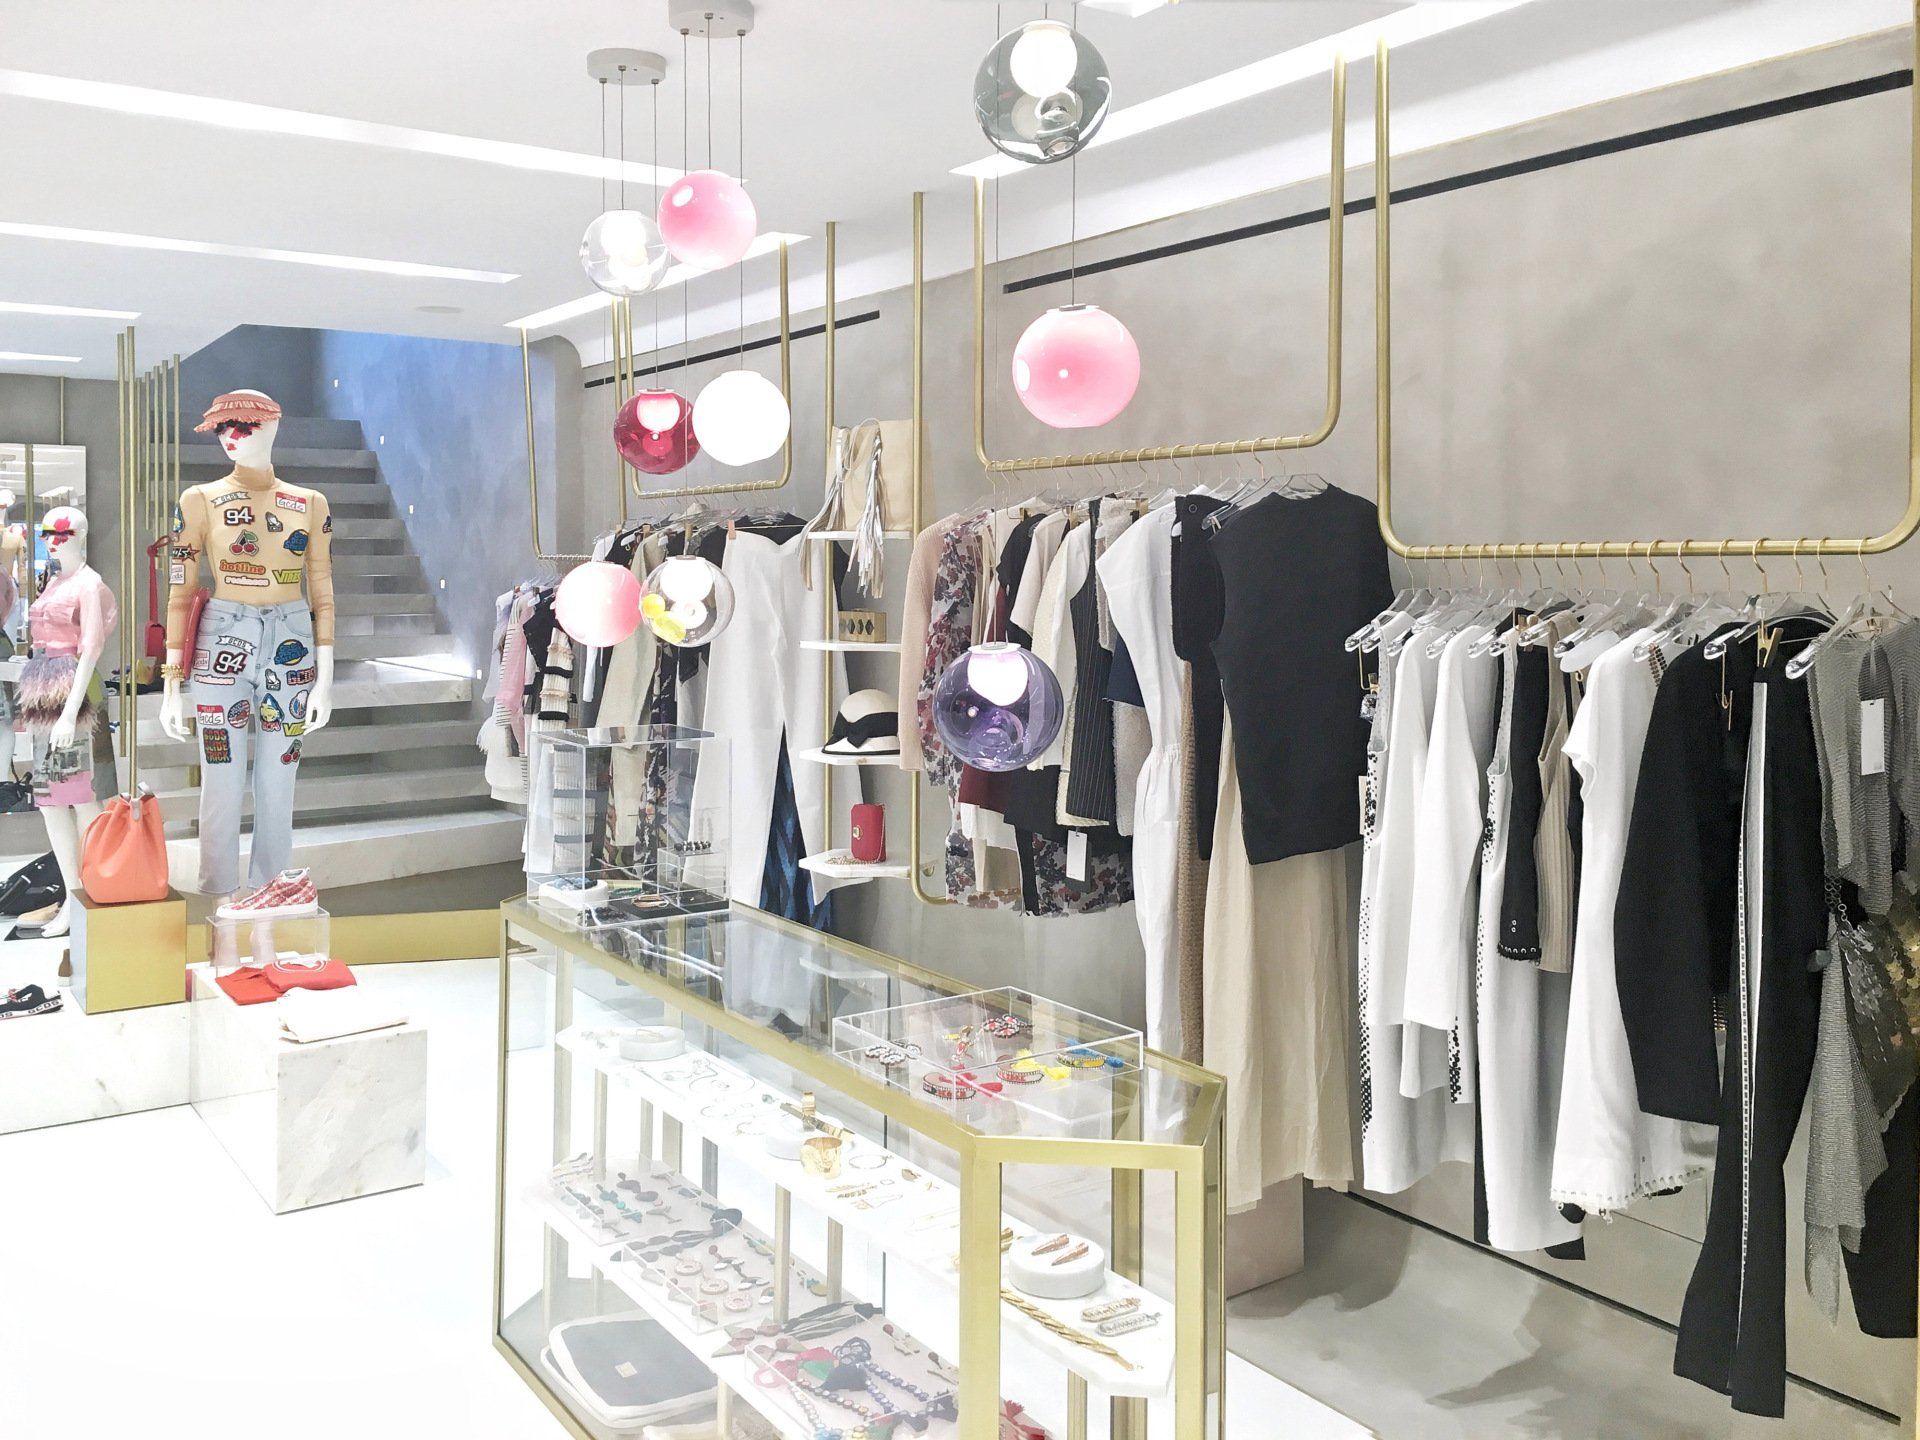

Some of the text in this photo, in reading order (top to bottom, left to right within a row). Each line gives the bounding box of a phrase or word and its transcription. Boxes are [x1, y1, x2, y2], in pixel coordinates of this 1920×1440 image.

[226, 507, 253, 524] 94
[220, 560, 265, 574] hotline
[216, 653, 243, 672] 94
